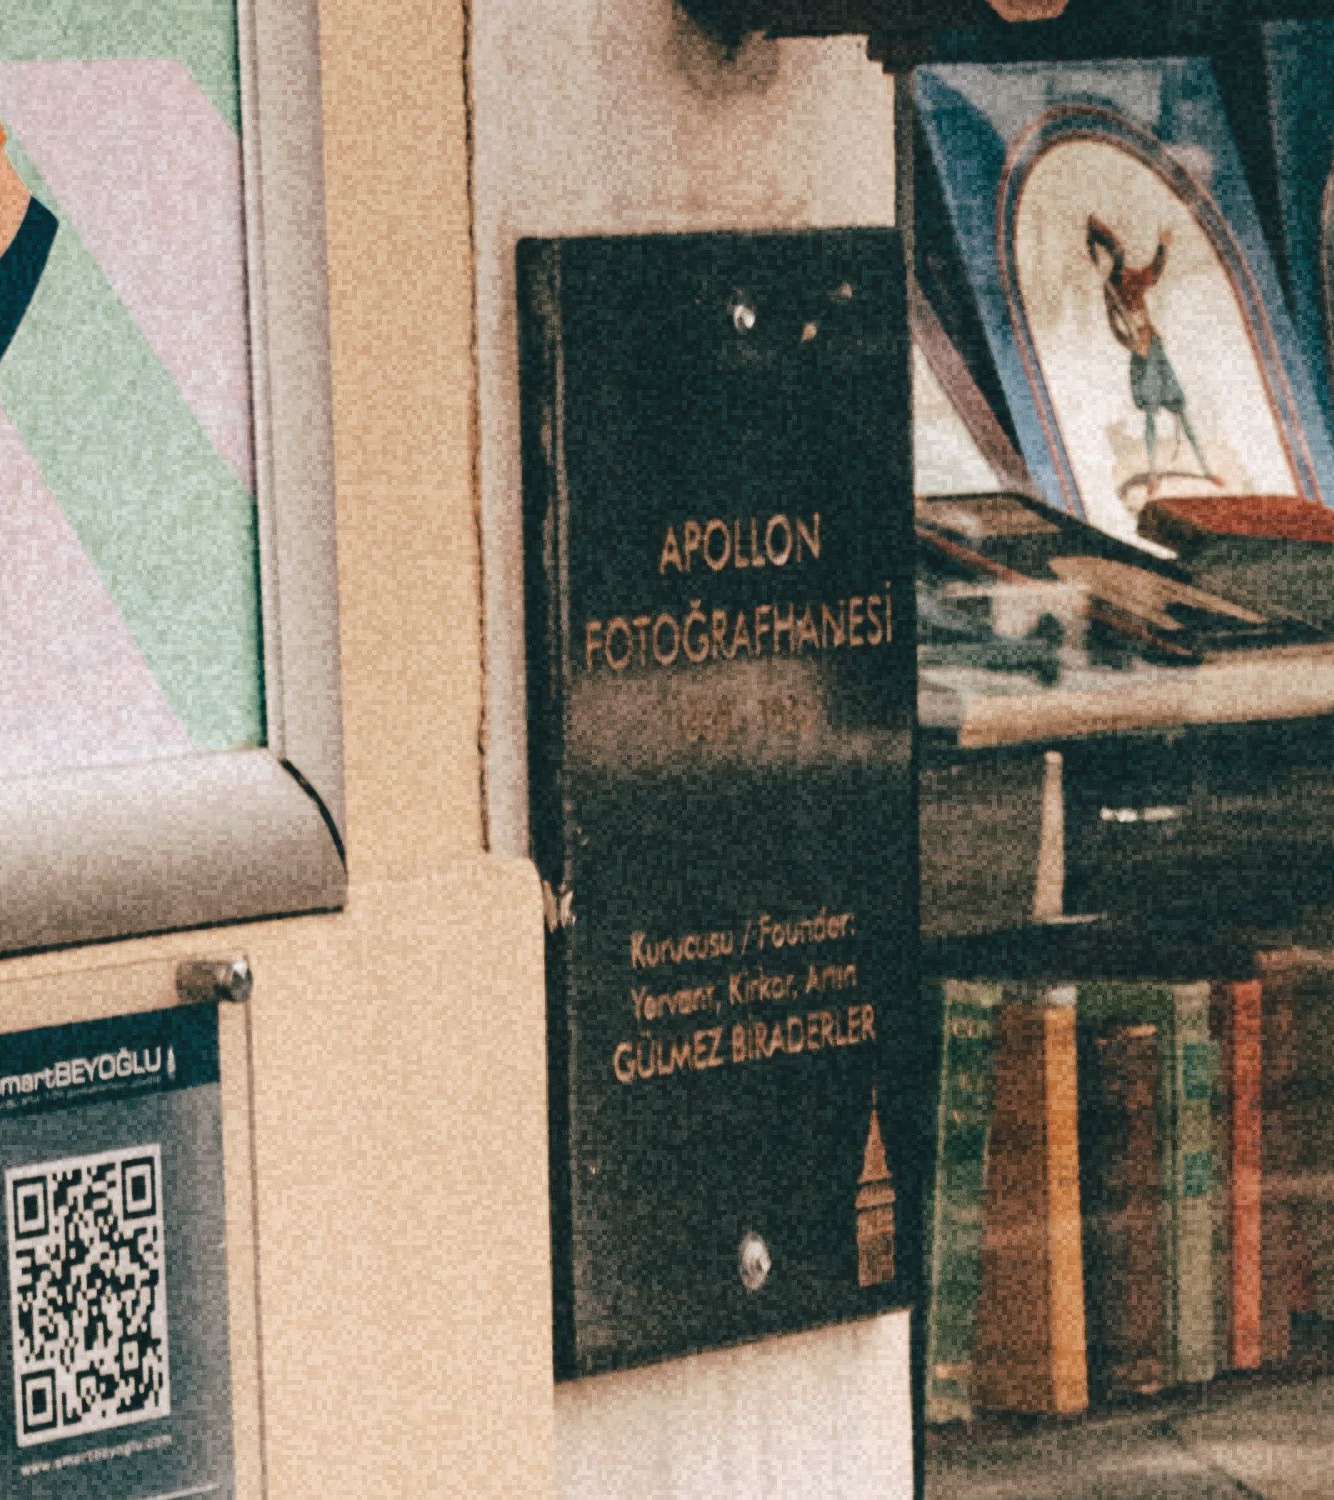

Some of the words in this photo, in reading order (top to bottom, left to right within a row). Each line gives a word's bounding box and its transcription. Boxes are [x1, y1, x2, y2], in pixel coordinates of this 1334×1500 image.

[659, 511, 821, 576] APOLLON
[585, 580, 894, 674] FOTOĞRAFHANESİ
[630, 929, 734, 969] Kurucusu
[740, 917, 753, 957] /
[612, 1028, 725, 1084] GÜLMEZ
[731, 1003, 877, 1064] BİRADERLER
